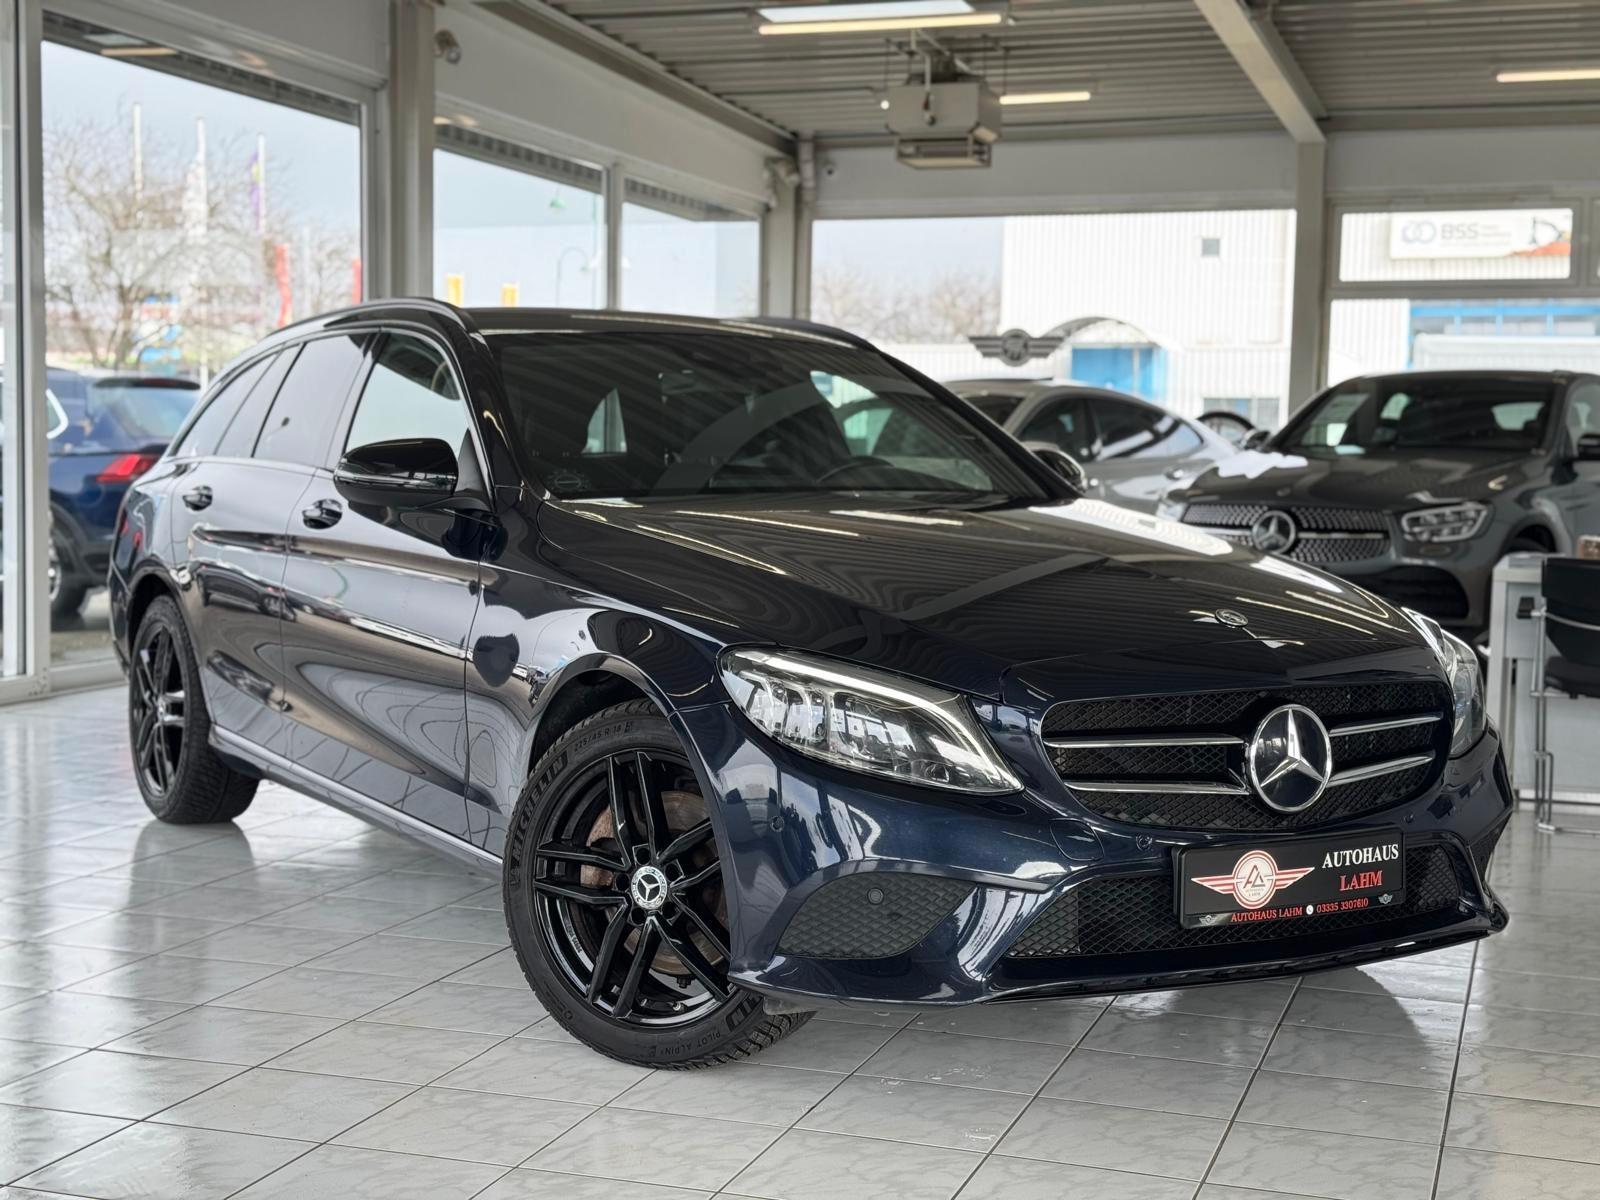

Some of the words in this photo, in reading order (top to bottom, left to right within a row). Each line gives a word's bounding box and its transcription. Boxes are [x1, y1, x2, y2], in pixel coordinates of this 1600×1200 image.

[1441, 223, 1479, 240] BSS
[512, 755, 564, 862] MICHELIN
[1322, 844, 1399, 868] AUTOHAUS
[1340, 871, 1383, 891] LAHM
[1230, 909, 1277, 923] AUTOHAUS
[1278, 907, 1303, 918] LAHM
[1316, 903, 1339, 913] 03335
[697, 1030, 721, 1049] PILOT
